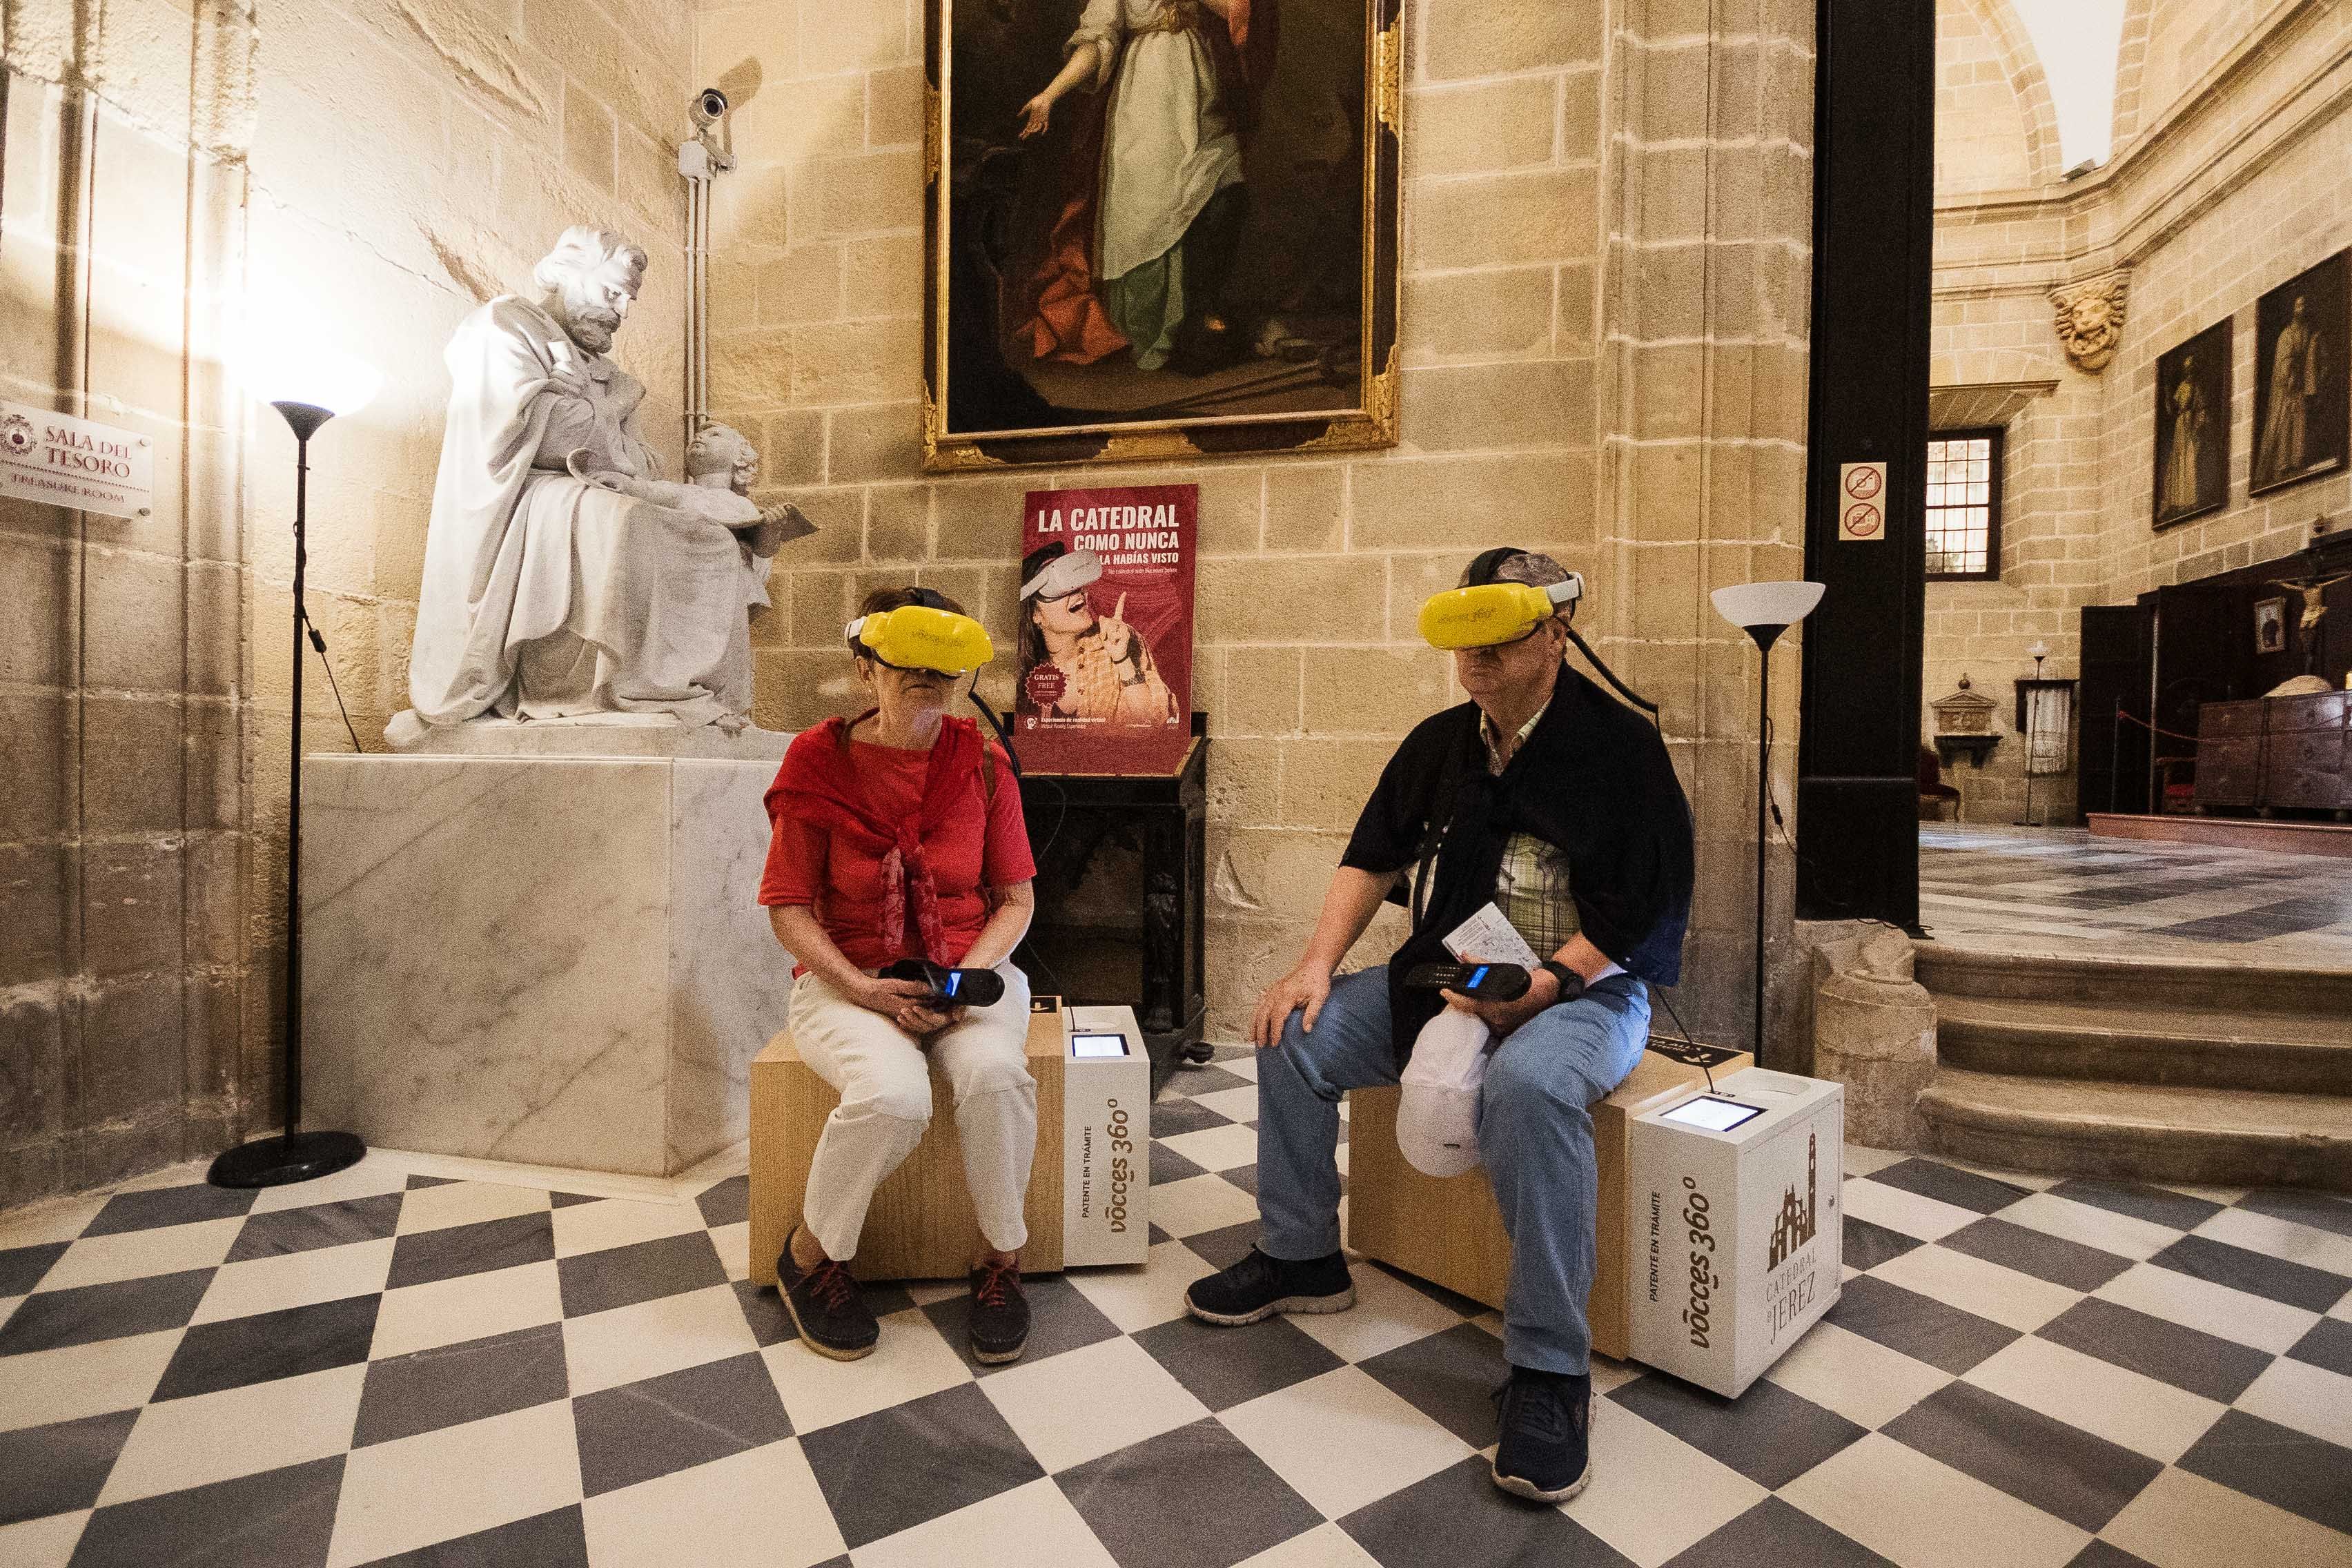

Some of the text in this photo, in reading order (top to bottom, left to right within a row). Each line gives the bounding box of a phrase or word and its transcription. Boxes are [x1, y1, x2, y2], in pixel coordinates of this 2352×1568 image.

[45, 425, 132, 460] SALA DEL
[45, 446, 130, 478] TESORO
[83, 487, 125, 503] ROOM
[1038, 504, 1179, 532] LA CATEDRAL
[1074, 531, 1179, 551] COMO NUNCA
[1113, 551, 1148, 565] HABÍAS
[1151, 552, 1179, 563] VISTO
[1083, 1166, 1090, 1179] EN
[1081, 1180, 1090, 1218] PATENTE
[1650, 1239, 1659, 1254] EN
[1649, 1255, 1658, 1302] PATENTE
[1766, 1248, 1816, 1302] CATEDRAL
[1770, 1271, 1815, 1345] JEREZ
